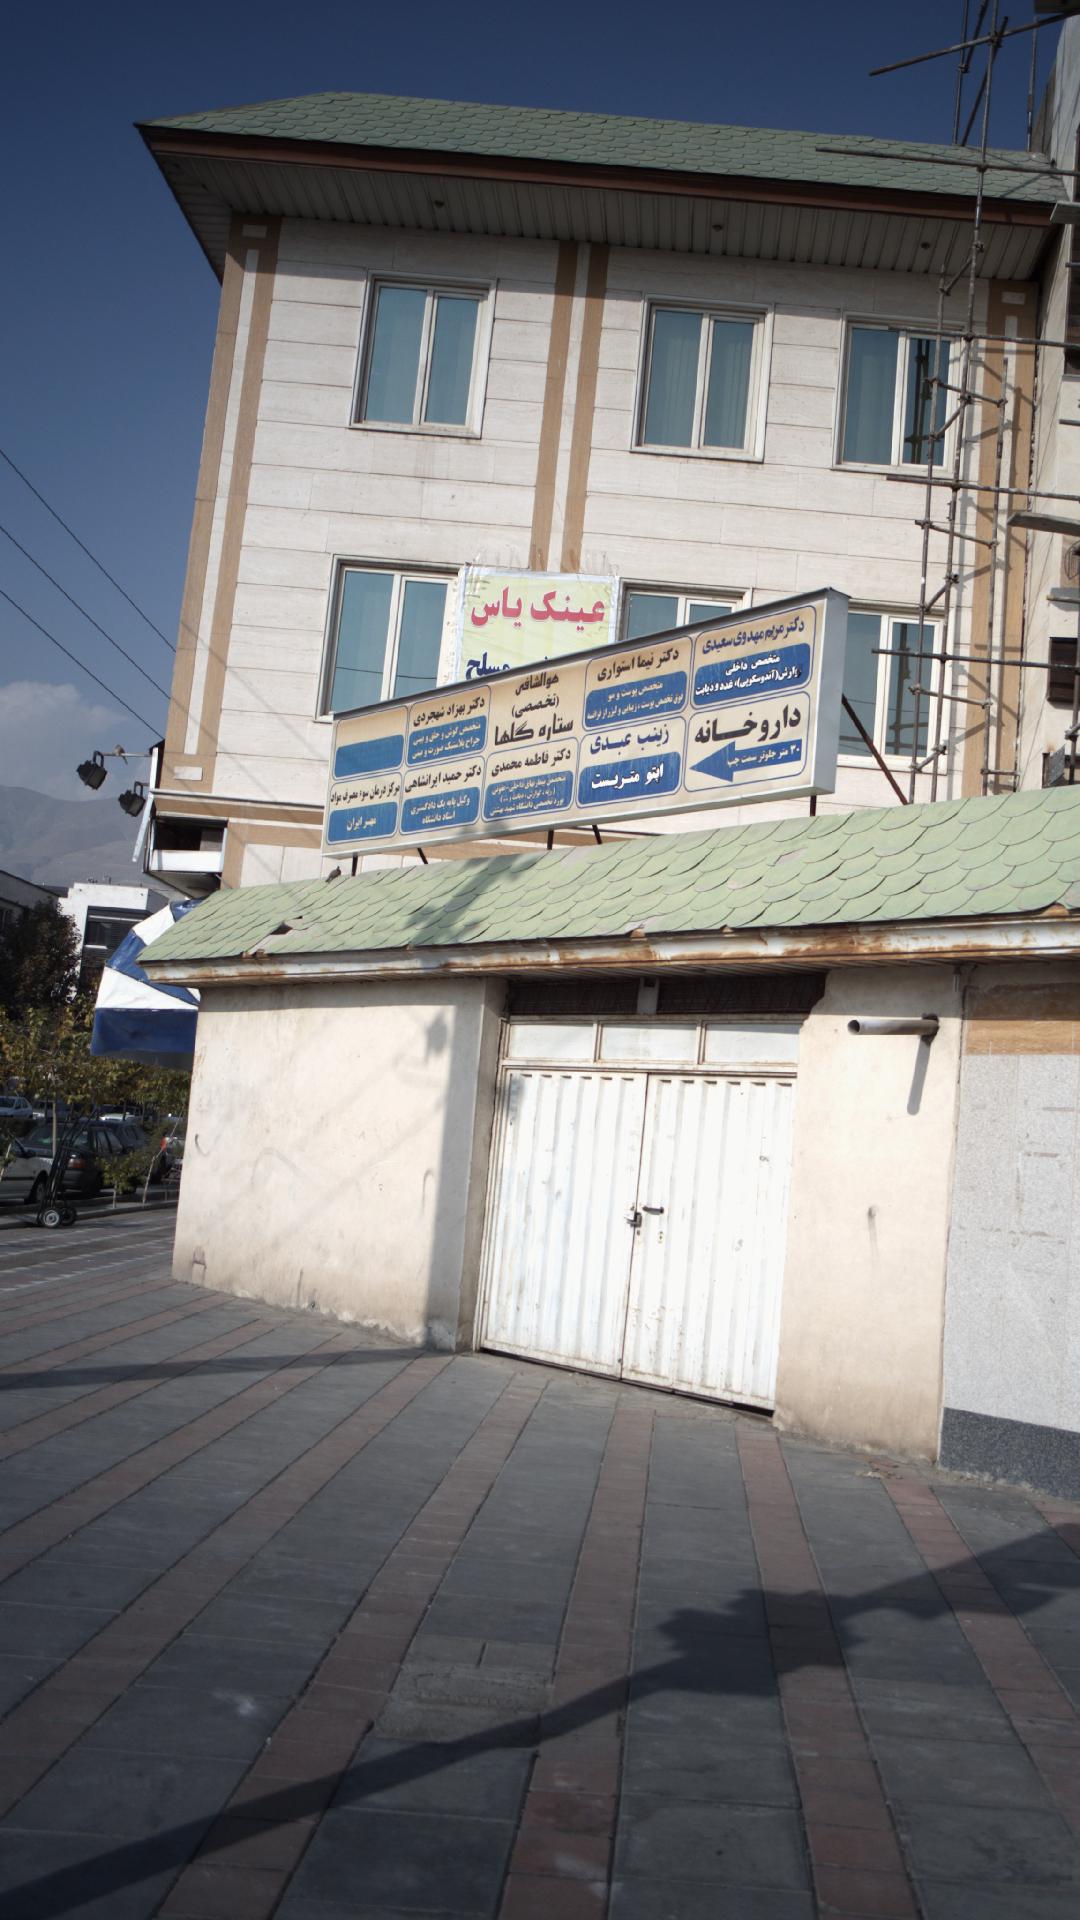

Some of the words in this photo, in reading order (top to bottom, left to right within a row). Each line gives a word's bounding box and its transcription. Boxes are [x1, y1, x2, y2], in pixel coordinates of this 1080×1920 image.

[471, 586, 522, 628] یاس
[530, 591, 605, 631] عینک
[765, 625, 785, 640] مریم
[784, 615, 805, 639] دکتر
[702, 636, 733, 654] سعیدی
[733, 630, 765, 648] مهدوی
[637, 653, 655, 670] نیما
[656, 648, 679, 668] دکتر
[750, 653, 781, 670] متخصص
[597, 656, 635, 682] استواری
[725, 662, 748, 676] داخلی
[695, 684, 714, 696] دیابت
[446, 703, 466, 718] بهزاد
[467, 696, 485, 714] دکتر
[511, 693, 560, 718] (تخصصی)
[538, 713, 574, 741] ستاره
[695, 704, 801, 743] داروخانه
[494, 720, 534, 746] گلها
[637, 724, 669, 750] زینب
[590, 732, 631, 755] عبدی
[524, 751, 549, 766] فاطمه
[551, 748, 571, 767] دکتر
[778, 748, 789, 760] متر
[464, 764, 482, 782] دکتر
[492, 760, 522, 777] محمدی
[442, 771, 462, 785] حمید
[370, 785, 386, 800] درمان
[387, 781, 400, 797] مرکز
